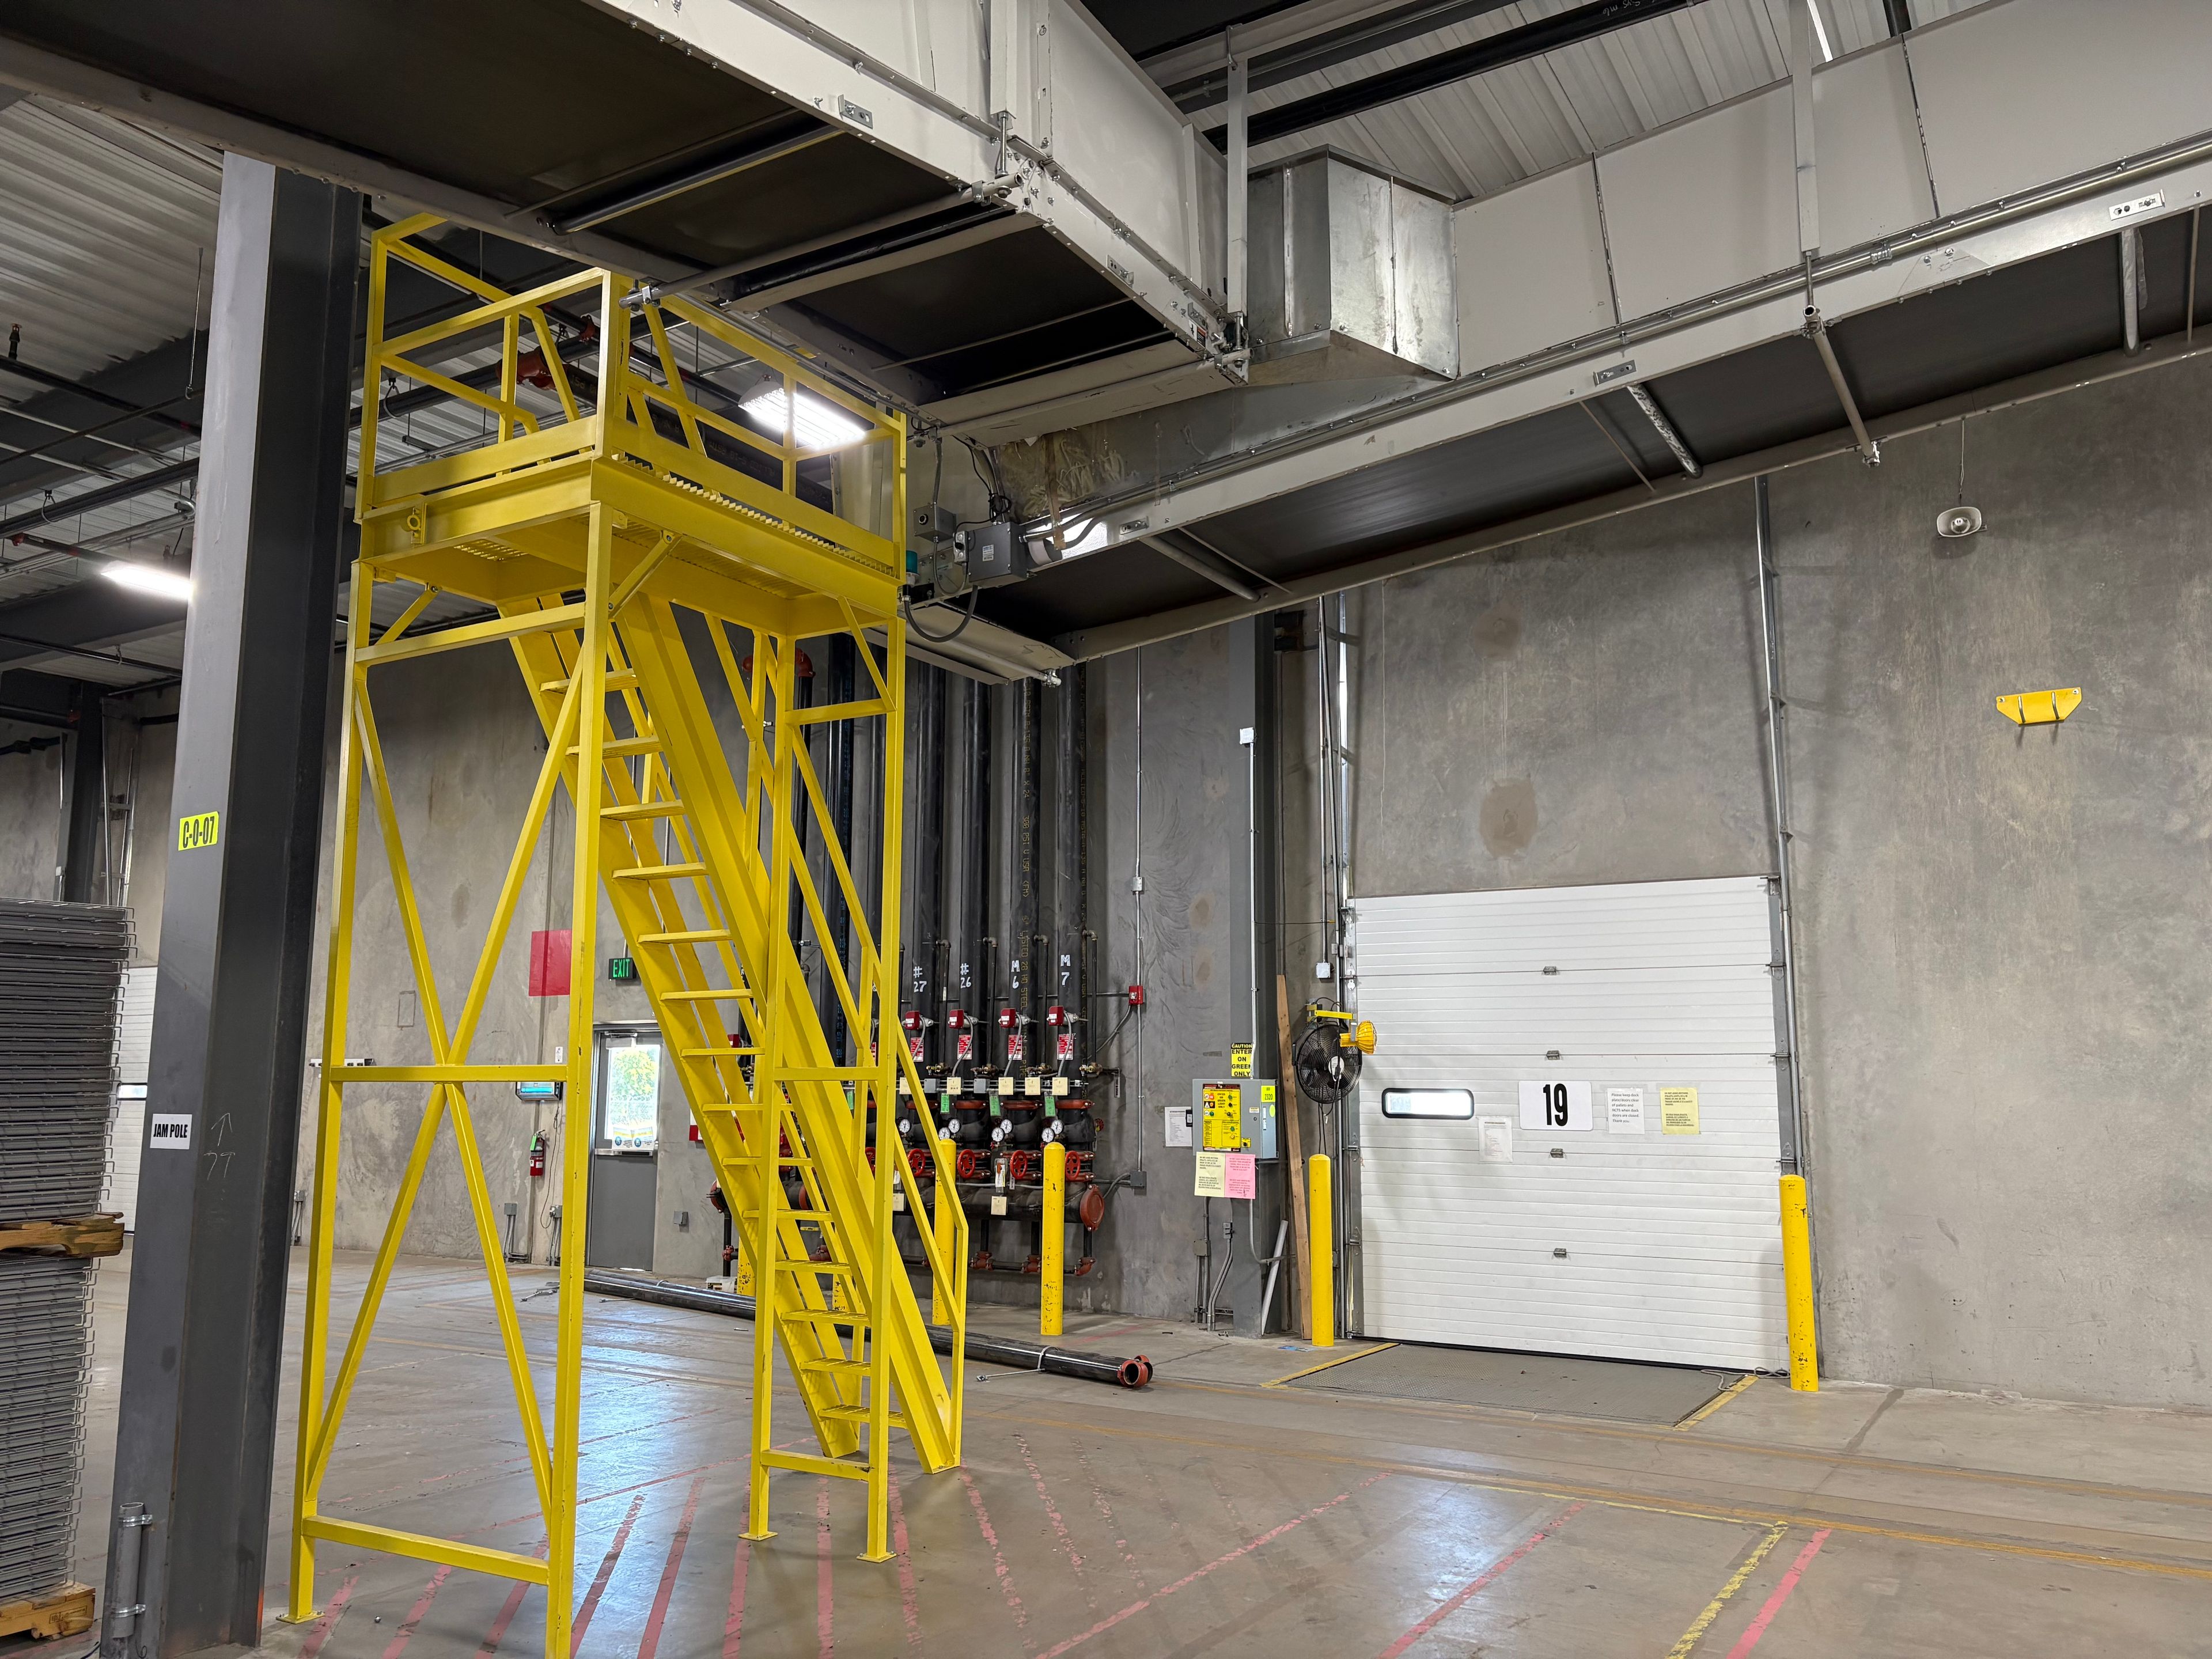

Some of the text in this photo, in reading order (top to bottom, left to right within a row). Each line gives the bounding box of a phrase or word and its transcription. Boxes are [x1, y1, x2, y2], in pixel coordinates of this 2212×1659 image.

[1011, 960, 1020, 972] M
[1060, 955, 1071, 966] M
[613, 959, 630, 978] EXIT
[914, 966, 923, 978] #
[960, 963, 969, 975] #
[960, 977, 972, 988] 26
[1012, 976, 1019, 989] 6
[1061, 972, 1070, 986] 7
[914, 980, 927, 993] 27
[1543, 1084, 1568, 1126] 19
[153, 1124, 188, 1138] JAM POLE
